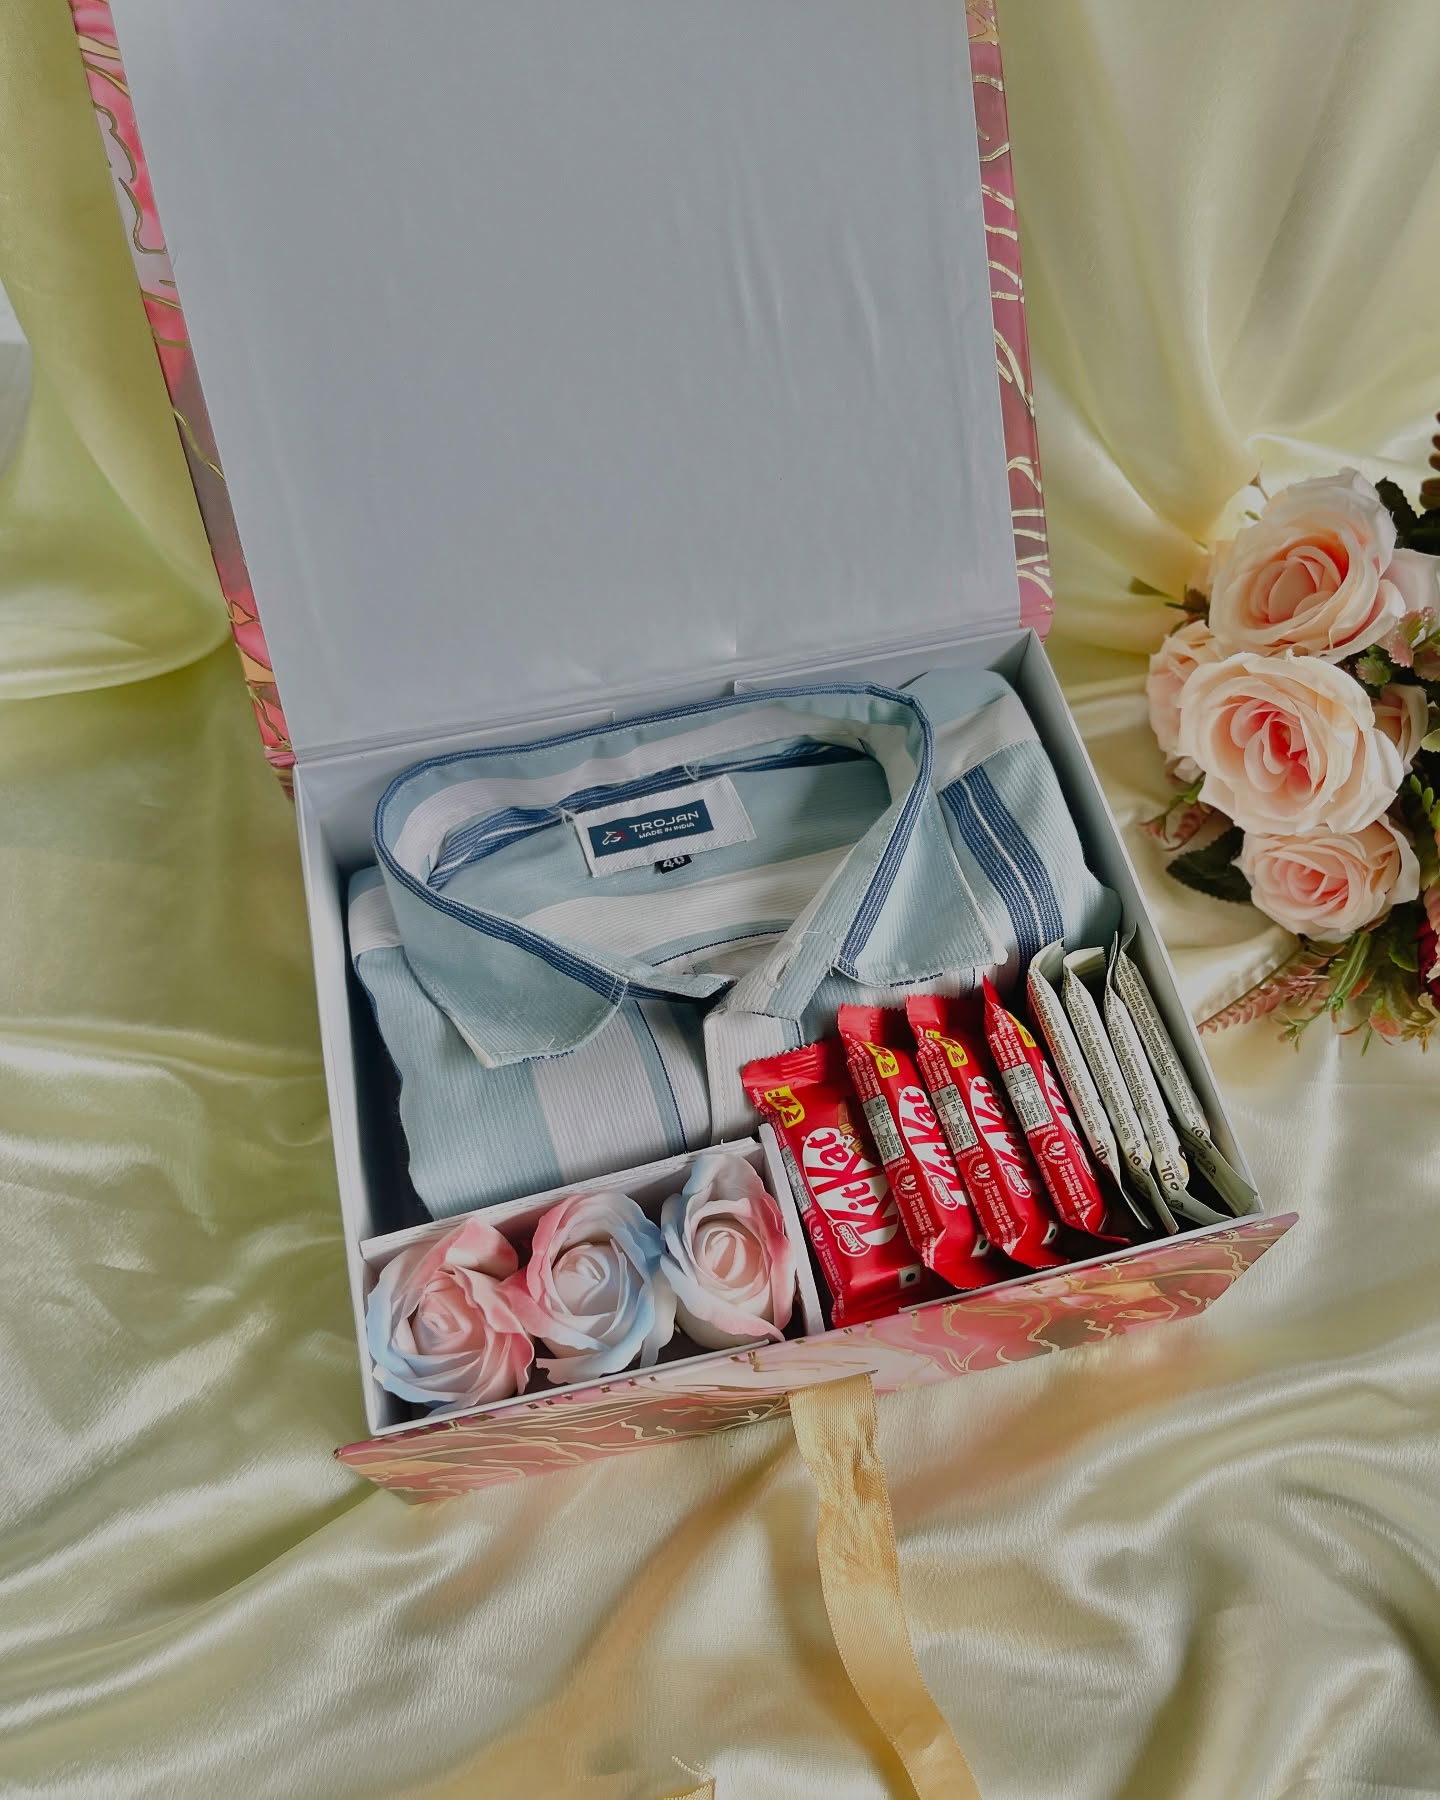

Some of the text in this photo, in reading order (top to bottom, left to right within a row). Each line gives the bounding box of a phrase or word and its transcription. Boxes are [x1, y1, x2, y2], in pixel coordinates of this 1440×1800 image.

[629, 811, 699, 833] TROJAN
[639, 828, 663, 839] MADE
[673, 822, 695, 832] INDIA
[803, 1132, 897, 1235] KitKat
